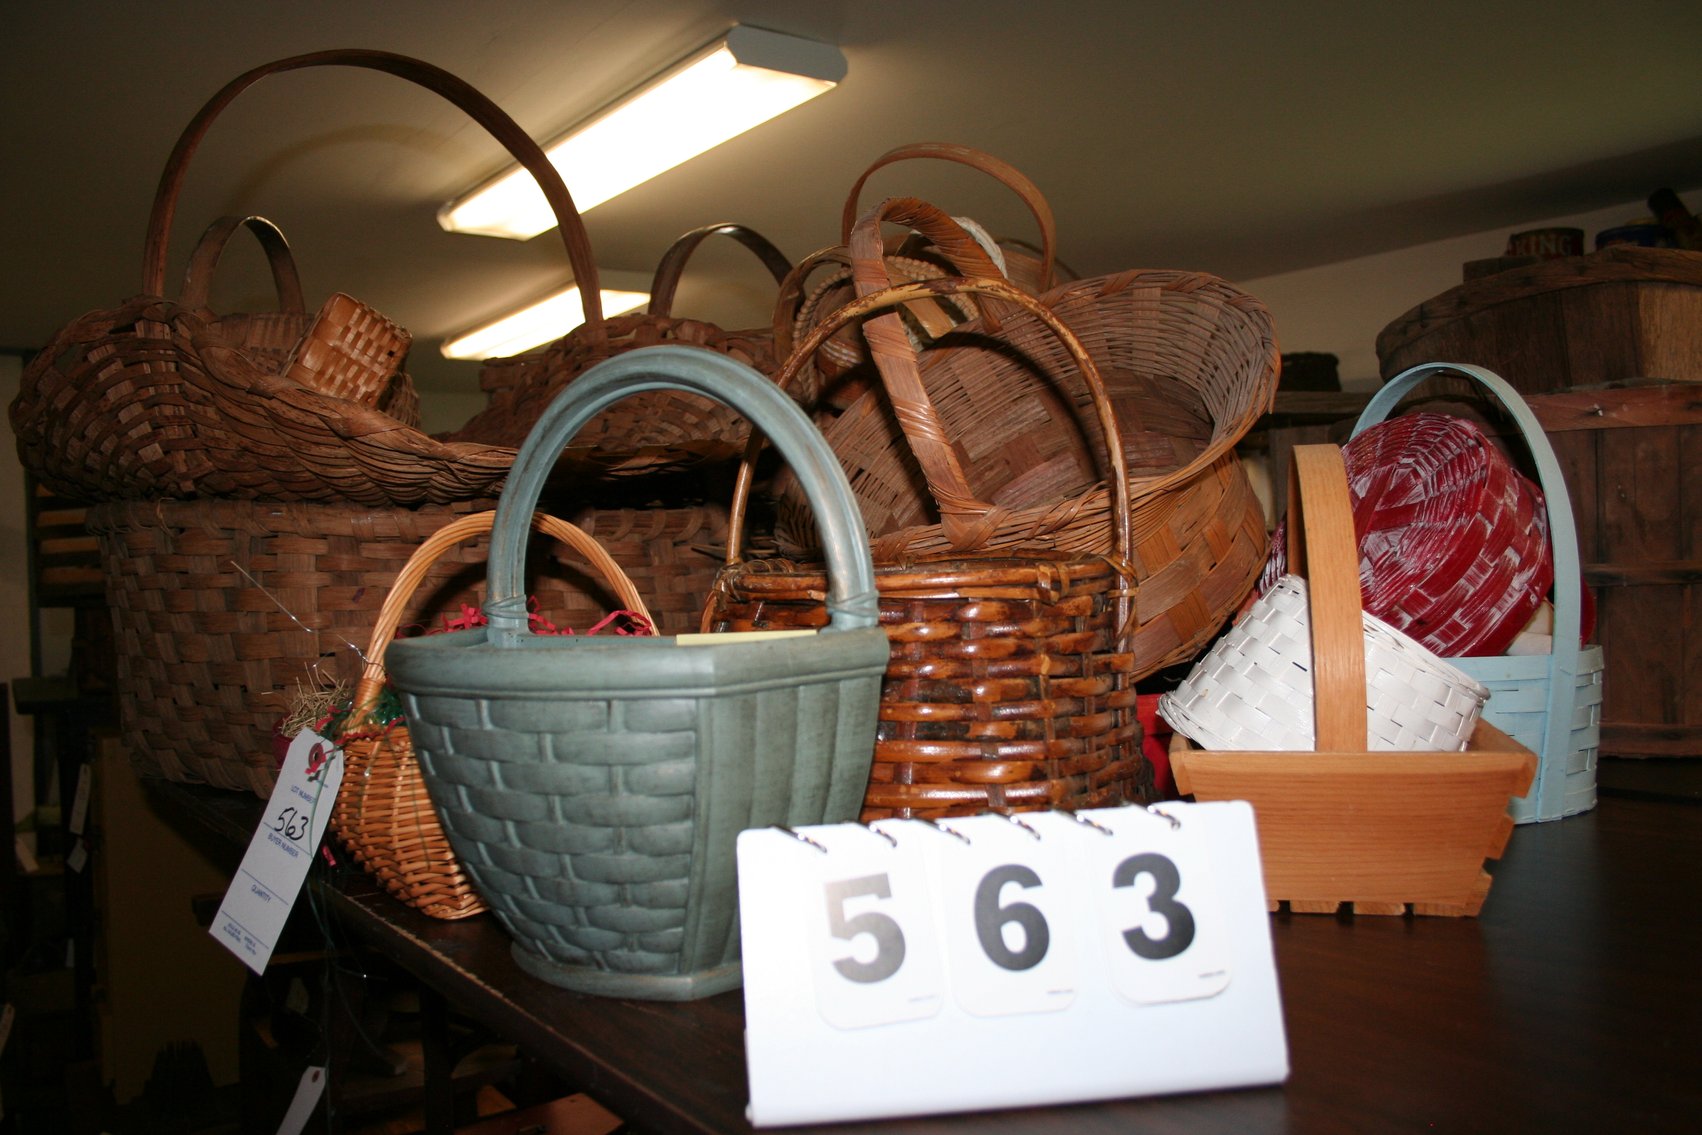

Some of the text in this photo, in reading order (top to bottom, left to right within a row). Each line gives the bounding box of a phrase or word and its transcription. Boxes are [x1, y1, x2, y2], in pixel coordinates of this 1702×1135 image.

[274, 806, 308, 841] 563
[268, 832, 299, 858] BUYER NUMBER
[250, 883, 272, 904] QUANTITY
